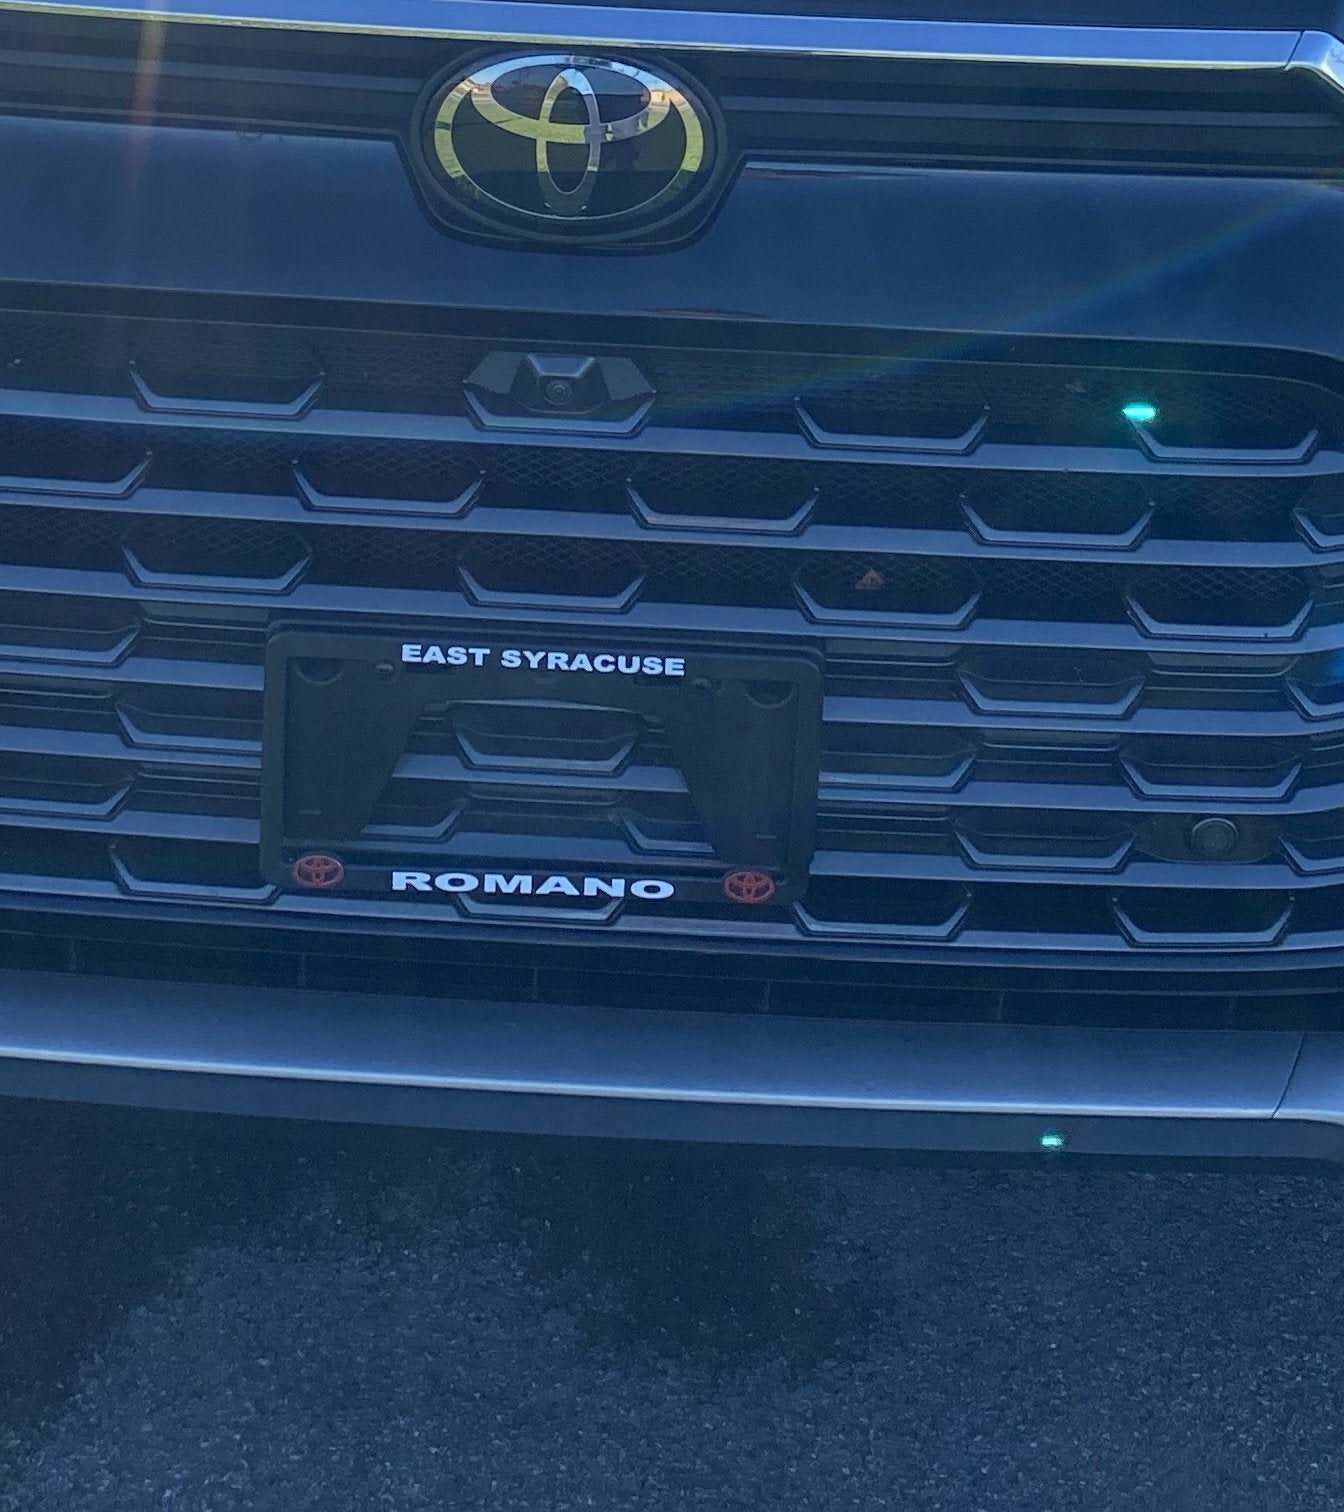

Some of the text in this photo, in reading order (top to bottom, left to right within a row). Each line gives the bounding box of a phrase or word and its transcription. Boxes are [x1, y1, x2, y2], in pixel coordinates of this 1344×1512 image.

[401, 643, 686, 677] EAST SYRACUSE
[391, 871, 675, 900] ROMANO
